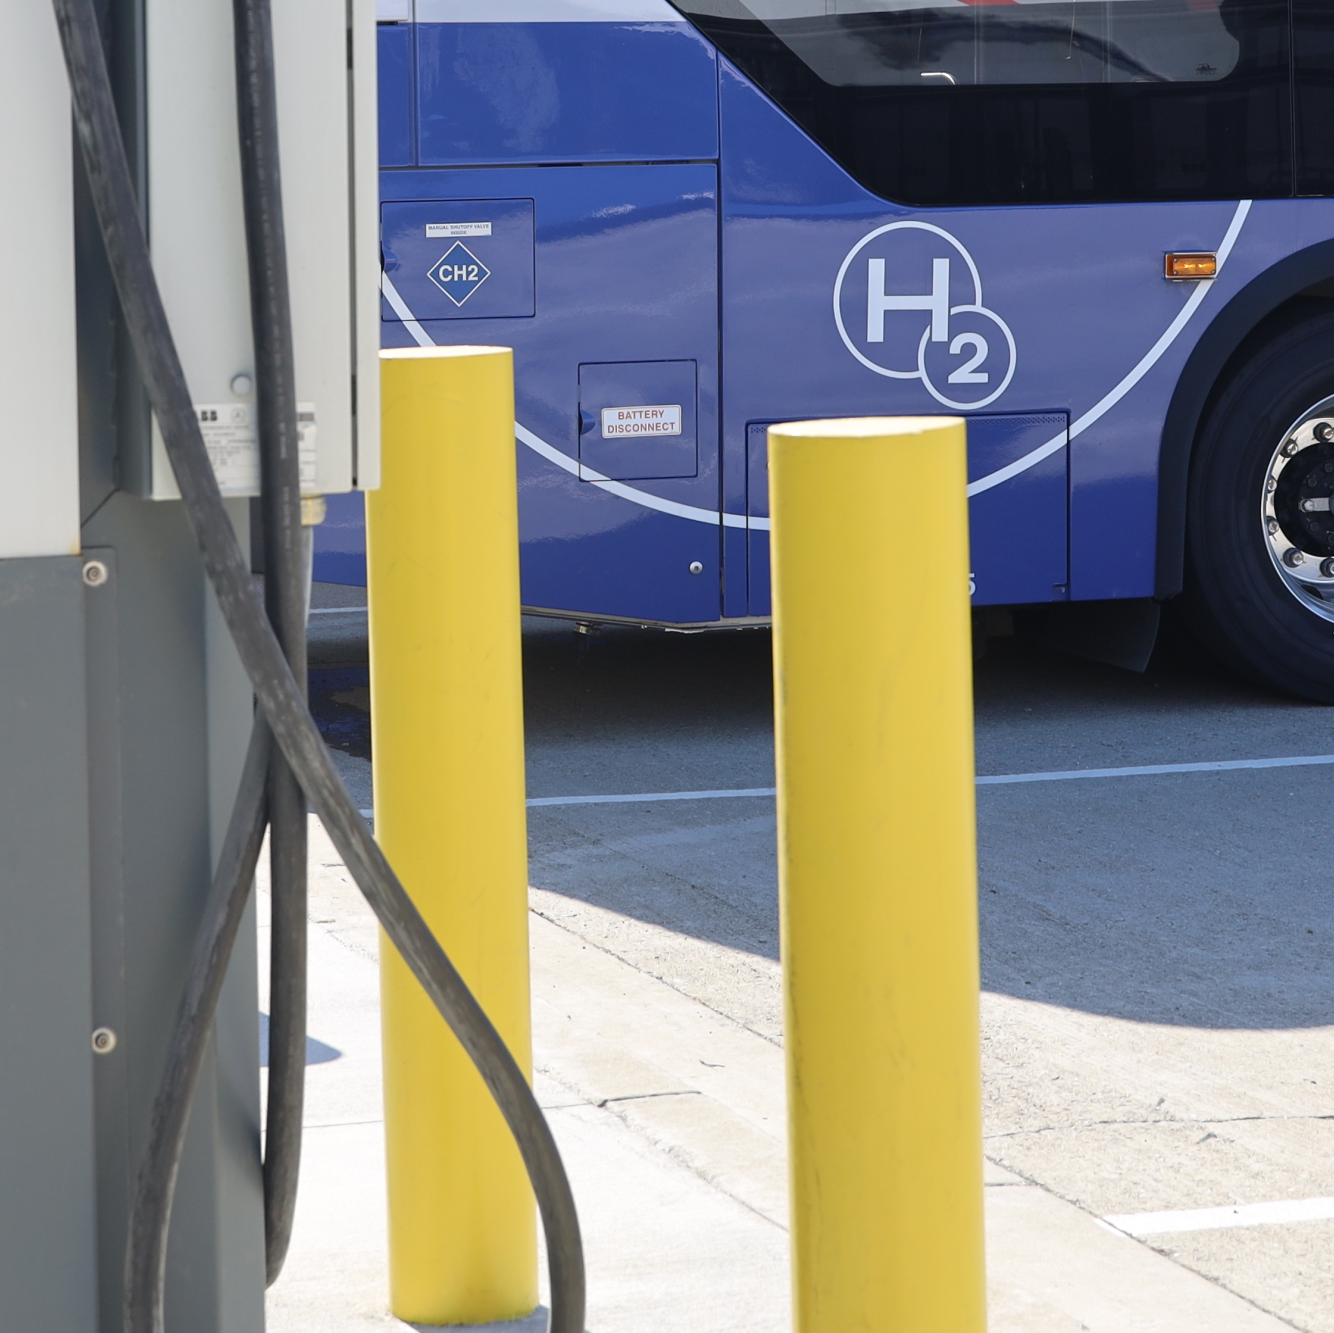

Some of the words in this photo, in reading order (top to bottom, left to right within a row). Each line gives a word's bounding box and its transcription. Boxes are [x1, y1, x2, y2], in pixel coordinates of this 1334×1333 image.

[438, 264, 479, 282] CH2
[197, 410, 218, 422] BB
[618, 410, 664, 420] BATTERY
[607, 422, 675, 434] DISCONNECT
